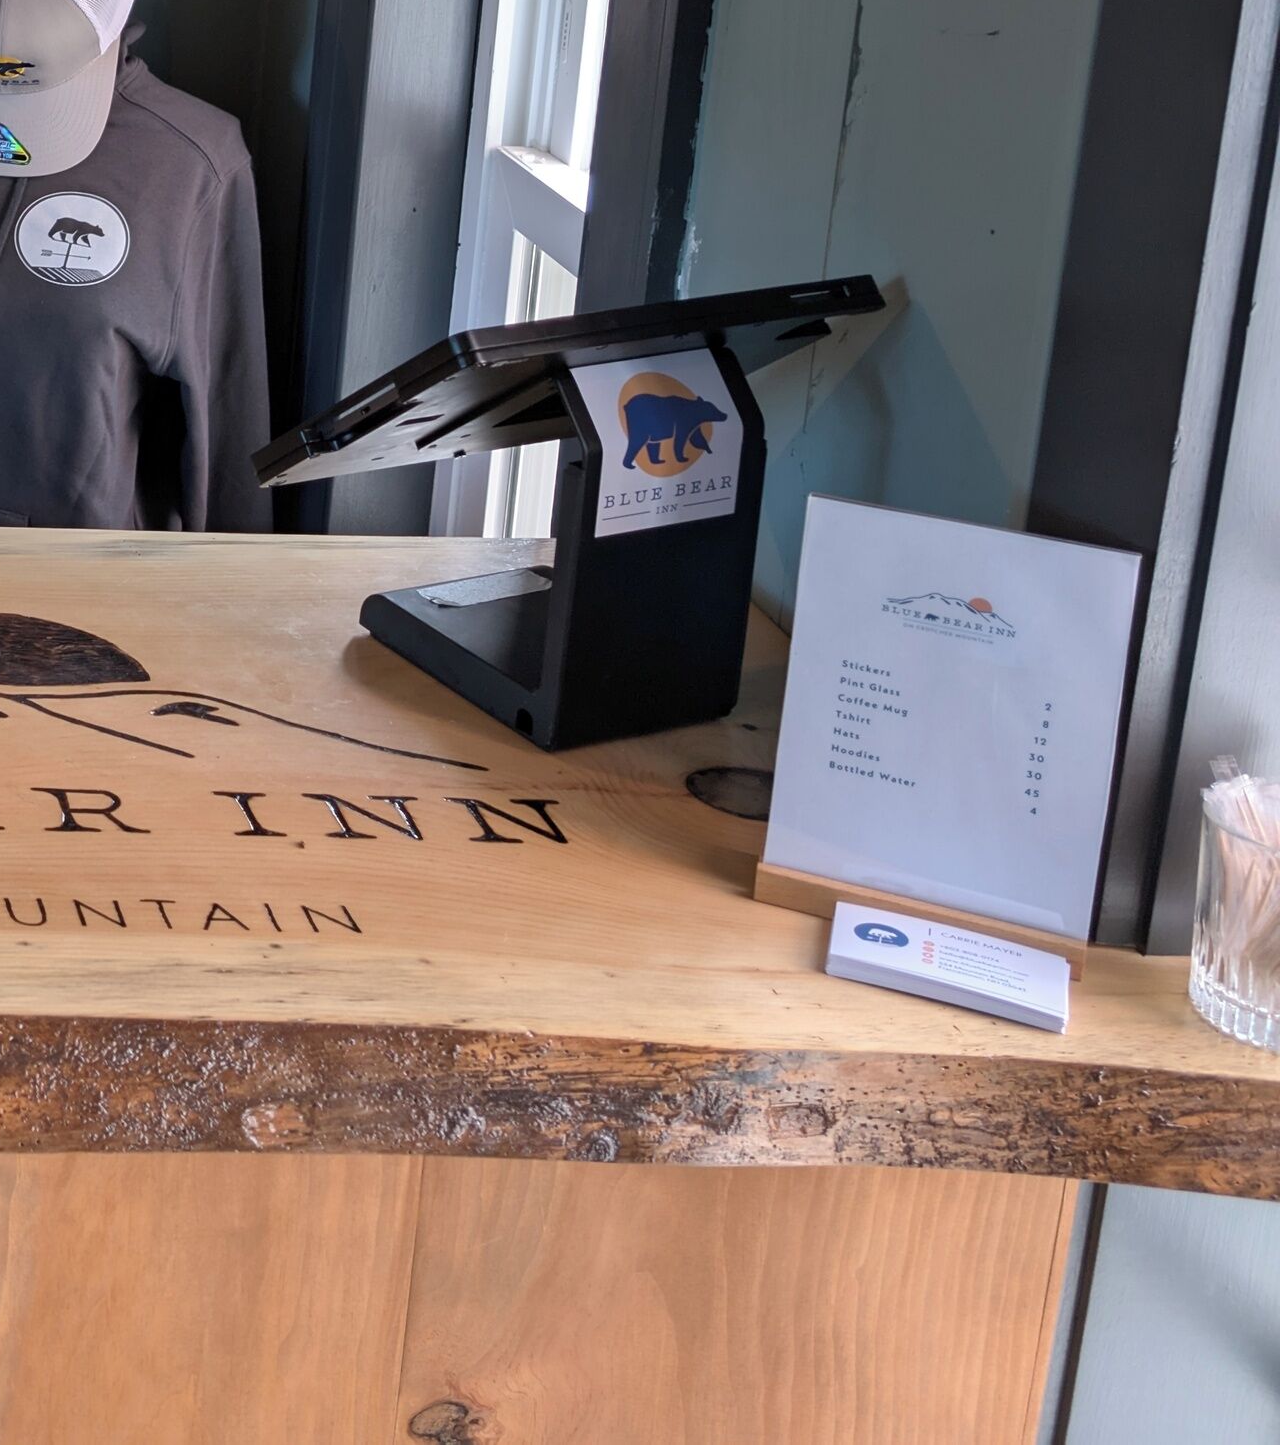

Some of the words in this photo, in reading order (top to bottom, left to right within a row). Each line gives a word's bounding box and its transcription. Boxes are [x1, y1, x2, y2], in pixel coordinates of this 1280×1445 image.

[604, 487, 663, 509] BLUE
[675, 475, 732, 497] BEAR
[656, 504, 679, 515] INN
[881, 604, 922, 619] BLUE
[942, 616, 983, 632] BEAR
[988, 626, 1016, 638] INN
[840, 676, 864, 689] Pint
[869, 683, 900, 696] Glass
[1043, 720, 1049, 729] 8
[842, 659, 891, 677] Stickers
[1045, 703, 1052, 711] 2
[836, 710, 871, 725] Tshirt
[1029, 753, 1044, 763] 30
[838, 693, 878, 709] Coffee
[883, 704, 908, 717] Mug
[1034, 736, 1047, 746] 12
[831, 744, 880, 762] Hoodies
[1024, 788, 1040, 798] 45
[833, 727, 860, 740] Hats
[1026, 770, 1042, 780] 30
[829, 761, 874, 778] Bottled
[880, 772, 916, 787] Water
[1030, 807, 1037, 815] 4
[212, 790, 569, 845] INN
